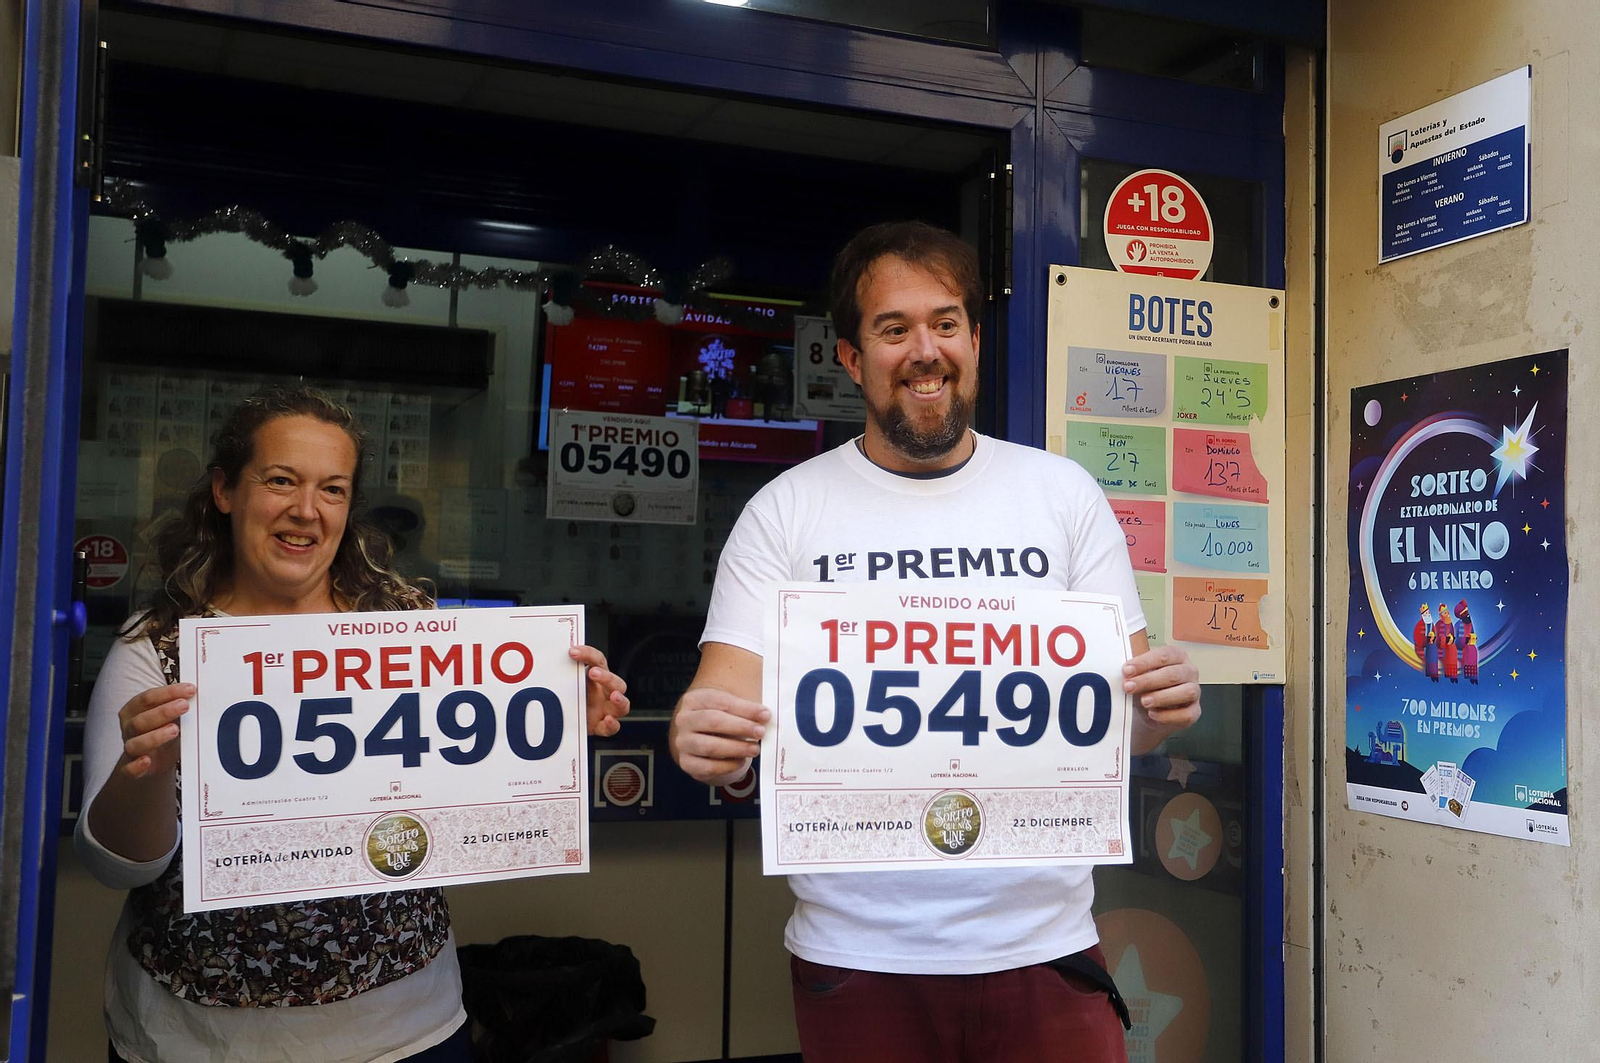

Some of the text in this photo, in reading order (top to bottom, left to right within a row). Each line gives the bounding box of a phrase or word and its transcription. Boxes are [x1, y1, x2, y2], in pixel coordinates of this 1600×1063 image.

[1410, 118, 1447, 136] Loterías y
[1410, 116, 1486, 149] Apuestas del Estado
[1432, 148, 1467, 167] INVIERNO
[1478, 150, 1499, 162] Sábados
[1403, 178, 1417, 187] Lunes
[1420, 172, 1437, 182] Viernes
[1128, 184, 1186, 224] +18
[1435, 192, 1465, 209] VERANO
[1478, 194, 1499, 206] Sábados
[1150, 226, 1201, 235] RESPONSABILIDAD
[1403, 220, 1416, 229] Lunes
[1420, 214, 1436, 224] Viernes
[1150, 256, 1194, 264] AUTOPROHIBIDOS
[681, 314, 732, 326] AVIDAD
[1128, 293, 1213, 338] BOTES
[1136, 334, 1151, 342] ÚNICO
[1152, 336, 1178, 344] ACERTANTE
[1178, 337, 1196, 345] PODRÍA
[1196, 339, 1212, 347] GANAR
[1106, 376, 1143, 402] 17
[1201, 388, 1251, 408] 24'5
[589, 425, 679, 447] PREMIO
[730, 441, 757, 449] Alicante
[561, 442, 690, 479] 05490
[1106, 452, 1139, 472] 2'7
[1204, 458, 1240, 486] 13'7
[1411, 468, 1487, 498] SORTEO
[1400, 500, 1498, 518] EXTRAORDINARIO DE
[1201, 532, 1253, 557] 10.000
[1390, 521, 1510, 563] EL NIÑO
[813, 547, 1050, 583] 1er PREMIO
[1408, 570, 1494, 590] 6 DE ENERO
[899, 596, 1016, 611] VENDIDO AQUÍ
[328, 616, 458, 636] VENDIDO AQUÍ
[820, 619, 1086, 668] 1er PREMIO
[243, 641, 534, 696] 1er PREMIO
[794, 667, 1112, 747] 05490
[1402, 698, 1496, 722] 700 MILLONES
[216, 686, 564, 780] 05490
[1417, 720, 1481, 739] EN PREMIOS
[242, 798, 292, 806] Administración
[1529, 789, 1554, 798] LOTERÍA
[1529, 797, 1561, 806] NACIONAL
[789, 820, 913, 832] LOTERÍA de NAVIDAD
[1013, 817, 1093, 827] 22 DICIEMBRE
[463, 829, 549, 844] 22 DICIEMBRE
[216, 846, 353, 868] LOTERÍA de NAVIDAD
